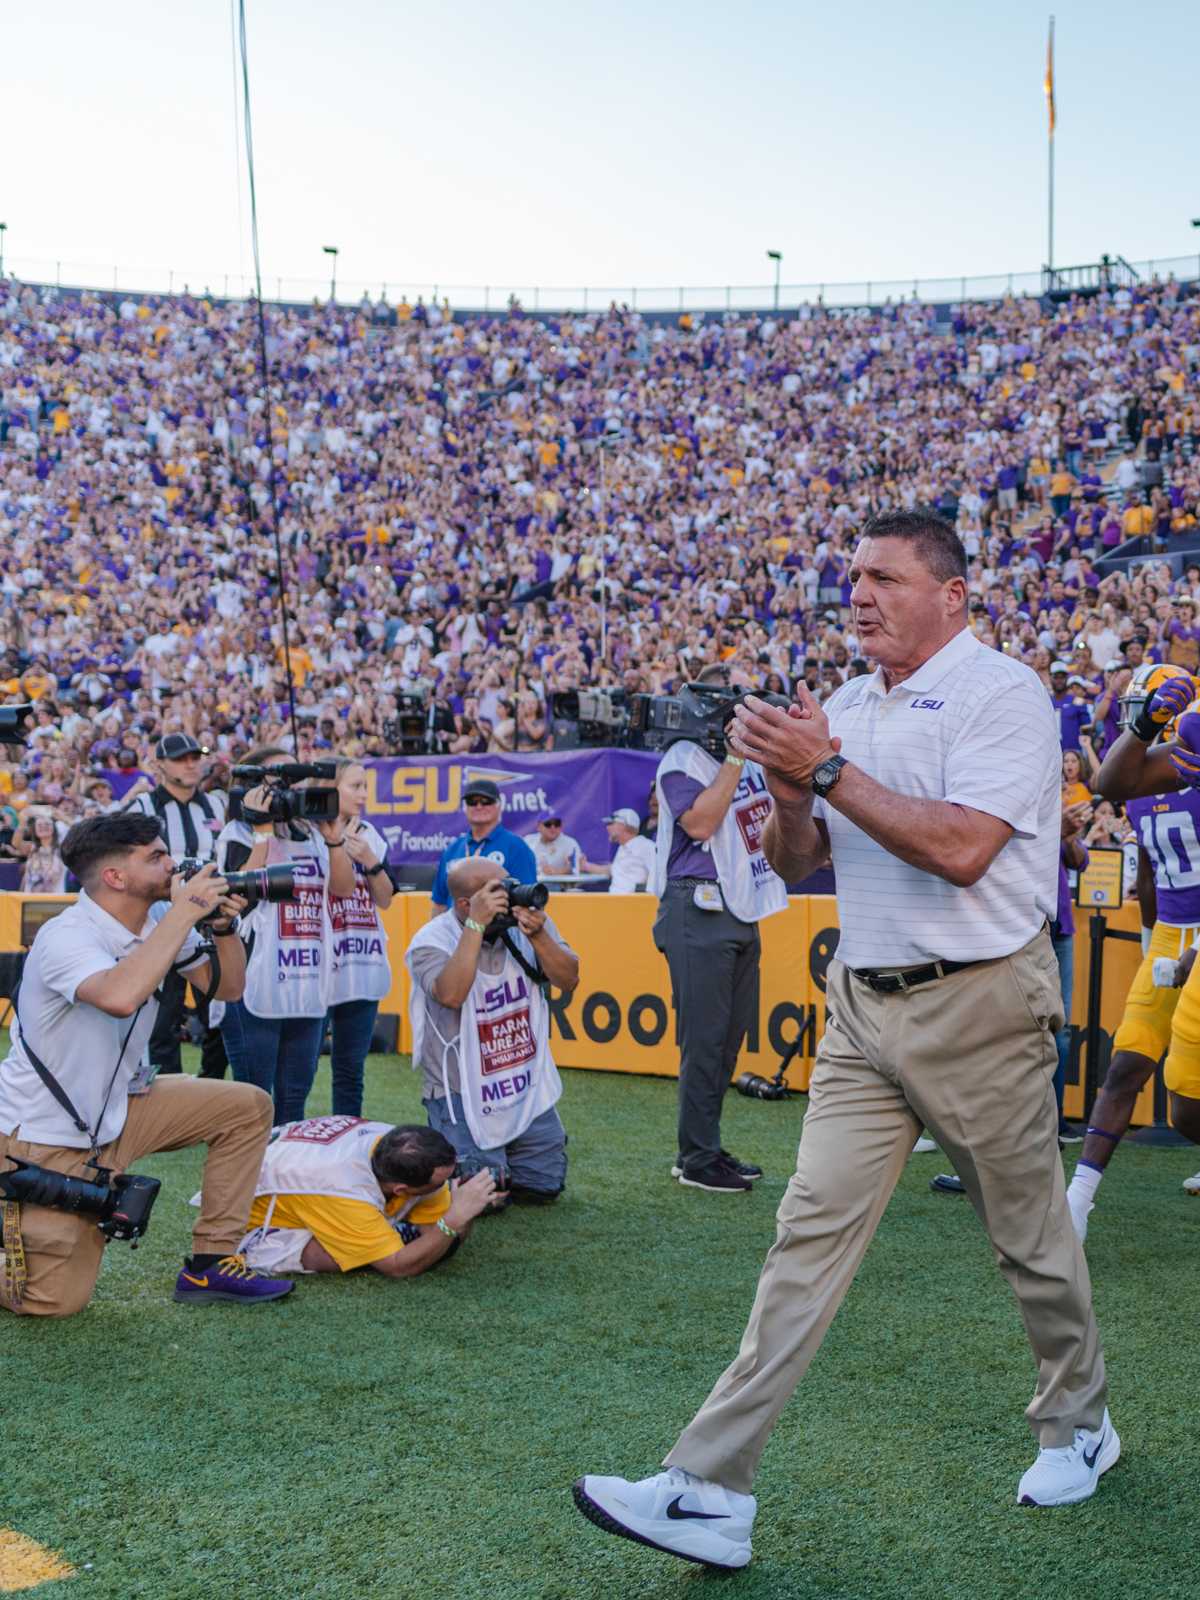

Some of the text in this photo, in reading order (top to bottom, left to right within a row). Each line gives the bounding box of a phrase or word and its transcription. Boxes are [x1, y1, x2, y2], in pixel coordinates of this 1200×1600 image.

[910, 698, 945, 711] LSU
[365, 766, 462, 816] LSU
[492, 1015, 529, 1039] FARM
[481, 1028, 530, 1055] BUREAU
